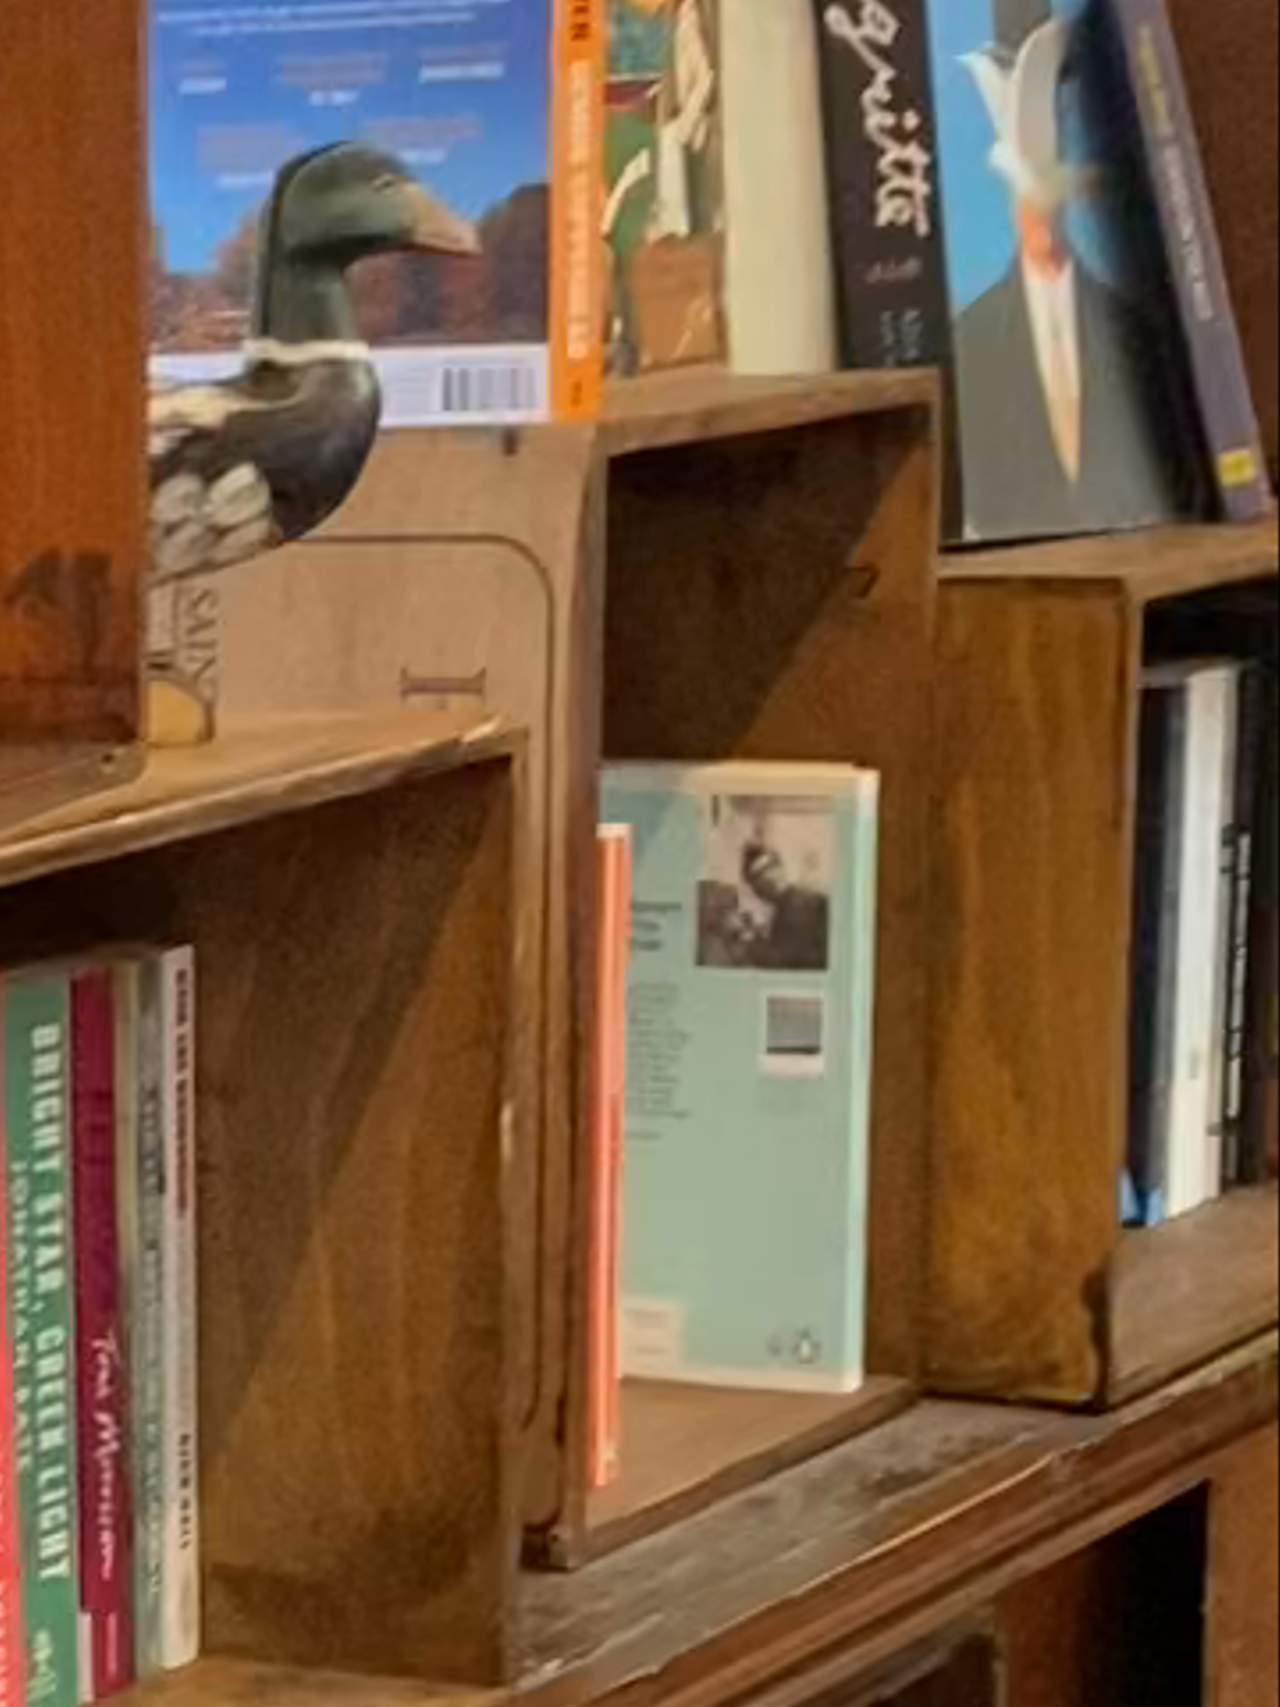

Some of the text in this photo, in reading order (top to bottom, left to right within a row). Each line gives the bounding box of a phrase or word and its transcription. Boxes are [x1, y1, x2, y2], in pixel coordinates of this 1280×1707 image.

[28, 1021, 70, 1582] BRIGHT STAR, GREEN LIGHT
